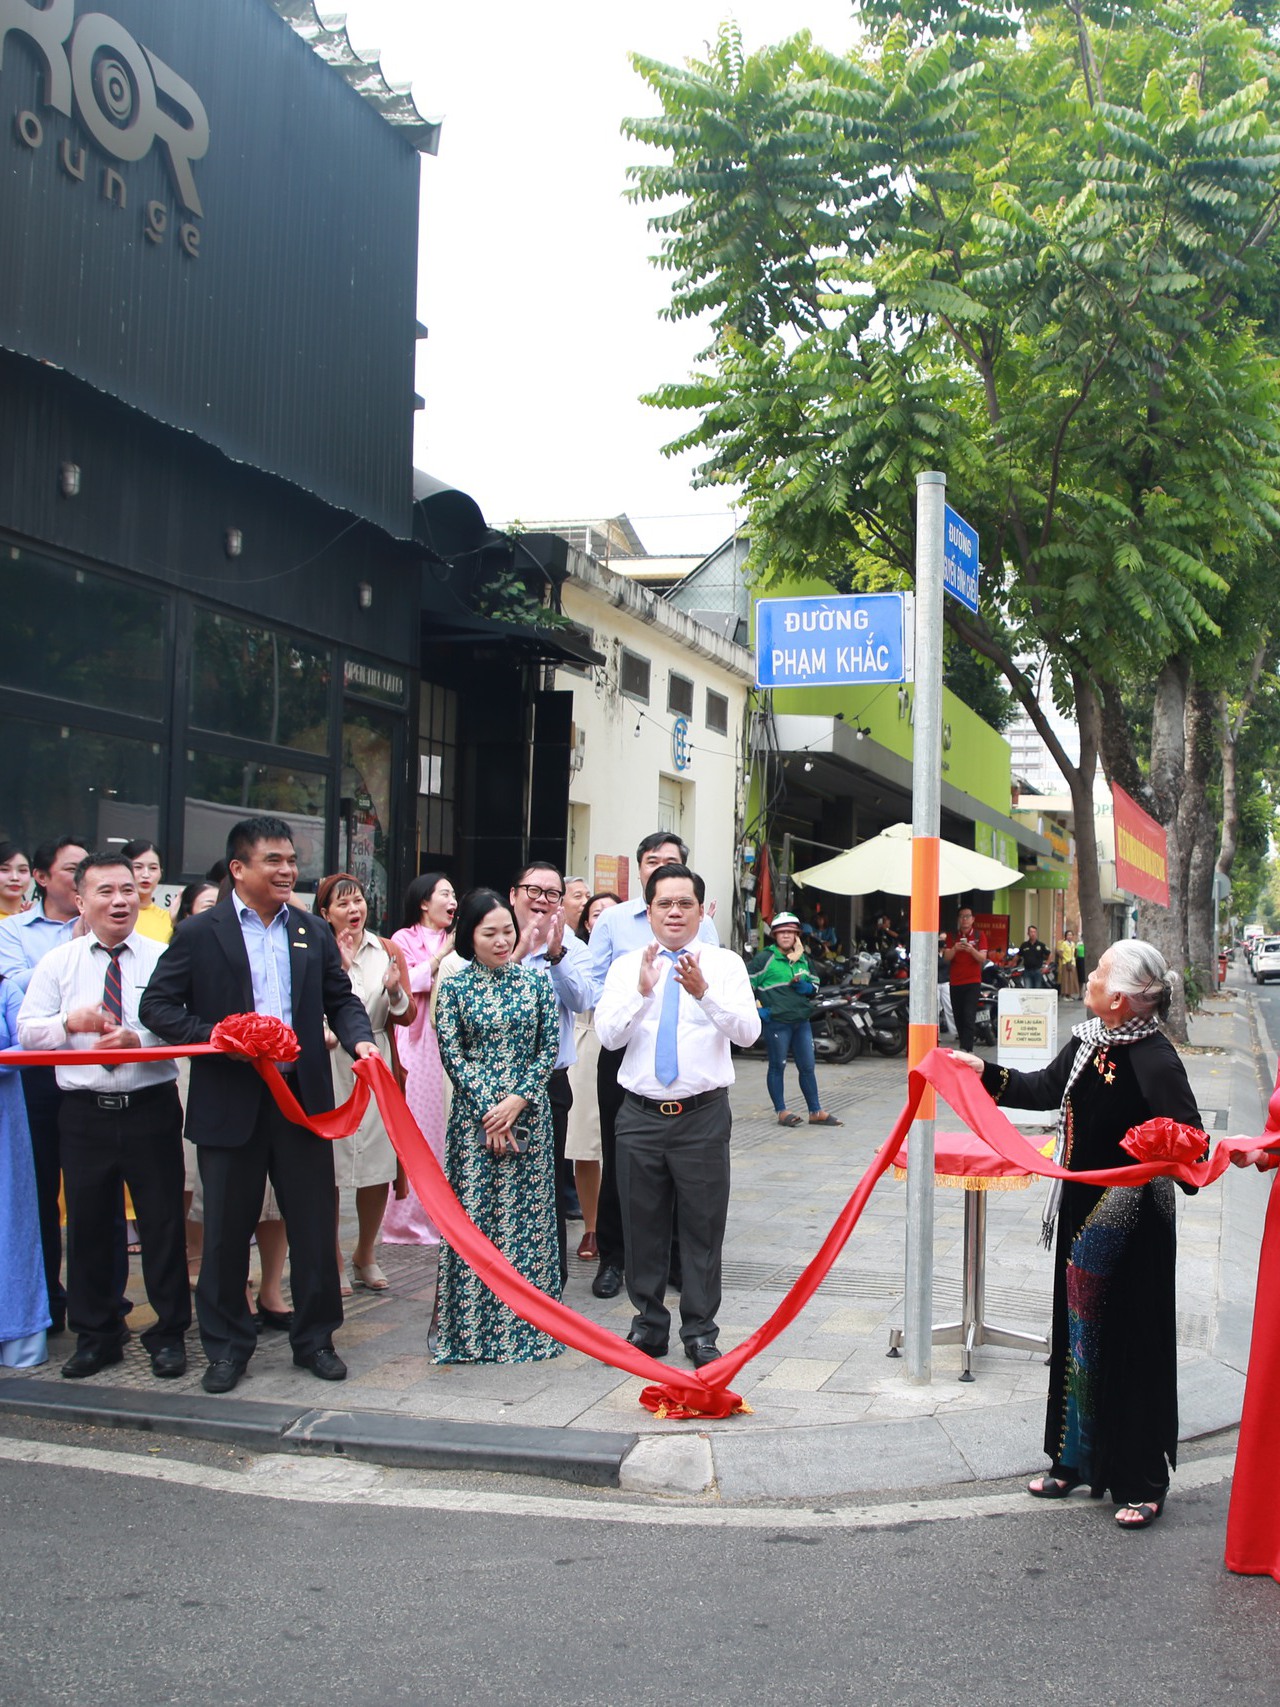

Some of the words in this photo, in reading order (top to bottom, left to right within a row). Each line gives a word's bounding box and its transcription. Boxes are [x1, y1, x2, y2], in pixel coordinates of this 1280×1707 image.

[948, 523, 972, 559] ĐƯỜNG
[784, 604, 869, 633] ĐƯỜNG
[772, 648, 826, 679] PHẠM
[836, 632, 889, 674] KHẮC
